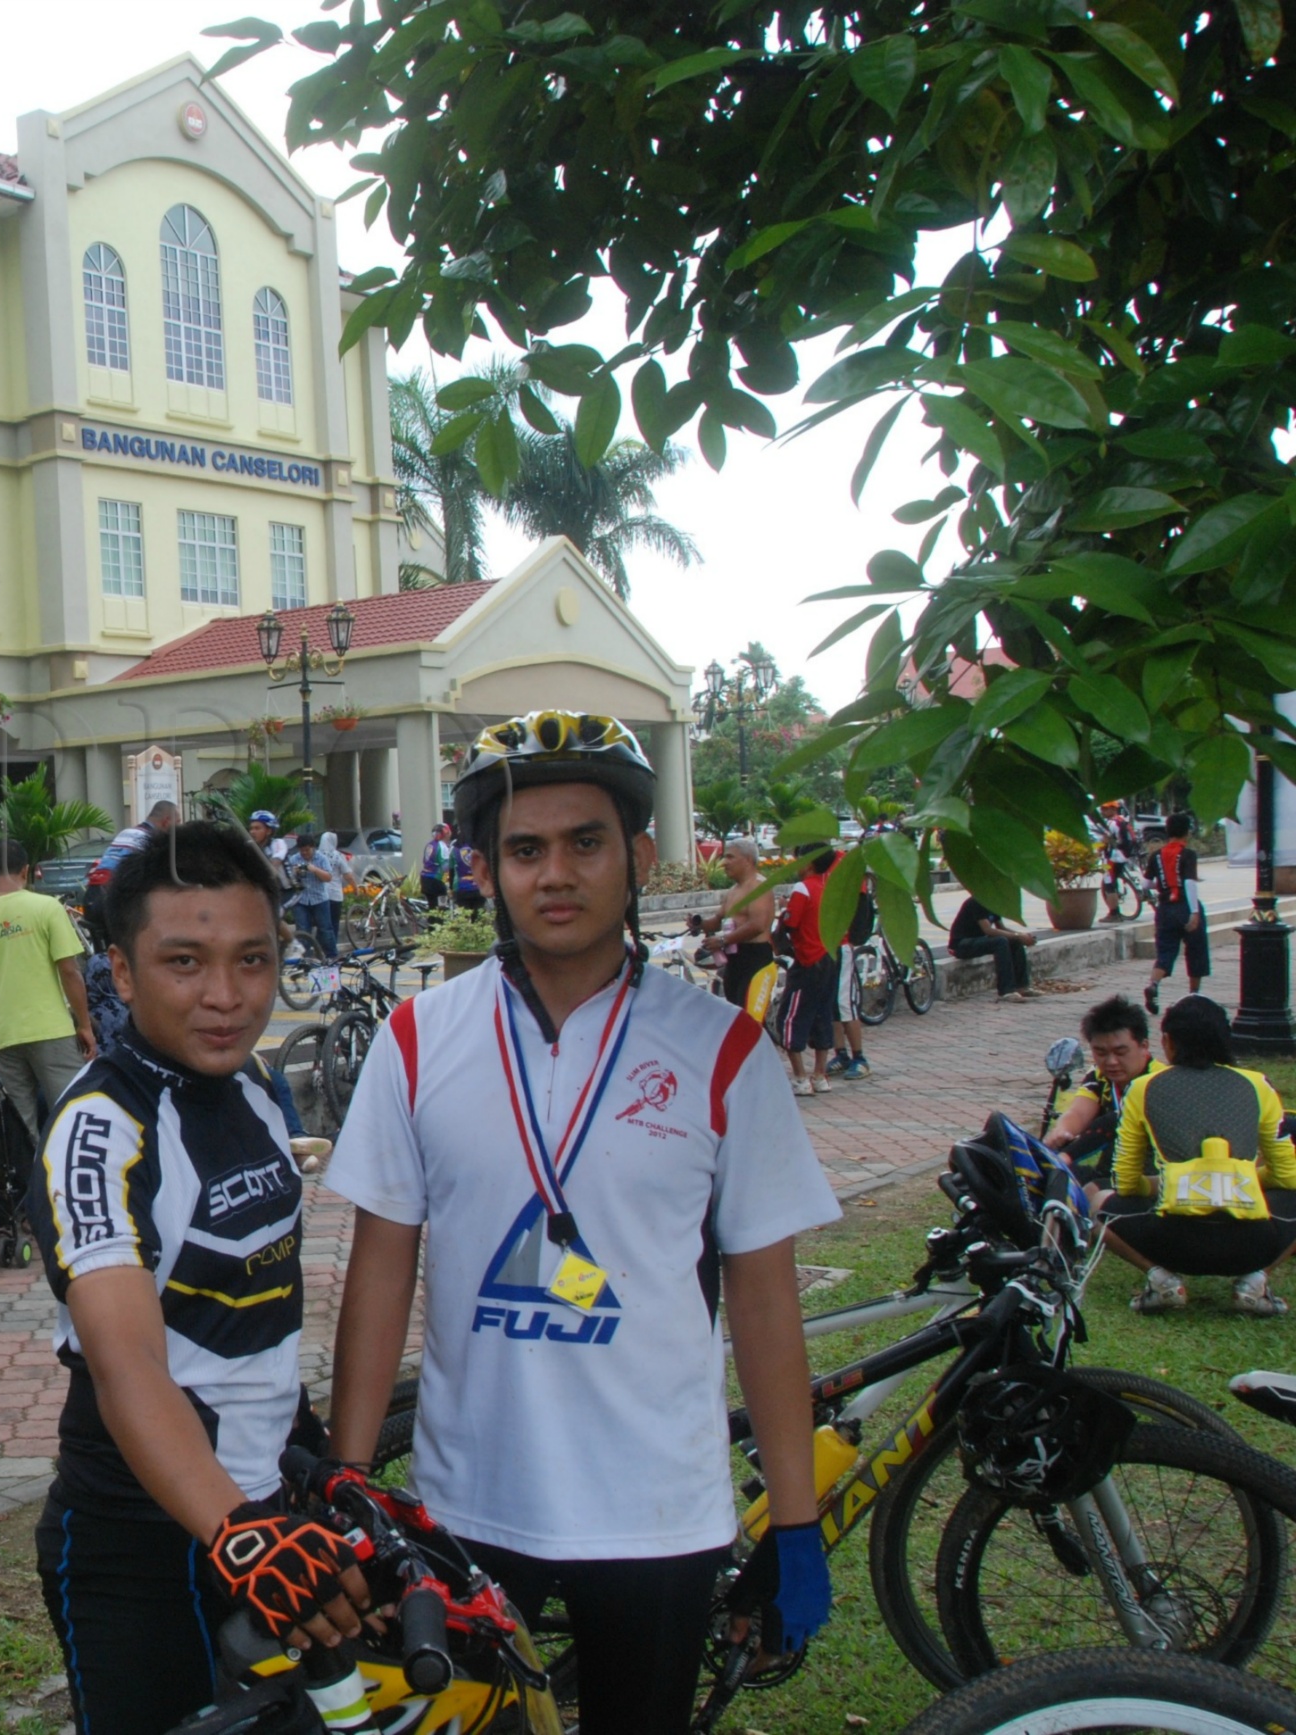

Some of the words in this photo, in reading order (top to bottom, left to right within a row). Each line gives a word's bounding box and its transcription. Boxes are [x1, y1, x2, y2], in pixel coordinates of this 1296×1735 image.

[81, 428, 206, 468] BANGUNAN
[211, 451, 320, 486] CANSELORI
[639, 1060, 659, 1071] RIVER
[627, 1118, 644, 1127] MTB
[645, 1122, 687, 1138] CHALLENGE
[648, 1130, 667, 1140] 2012
[70, 1113, 108, 1248] SCOTT
[209, 1160, 284, 1218] SCOTT
[471, 1305, 621, 1345] FUJI
[820, 1390, 938, 1548] IANT
[954, 1529, 979, 1590] KENDA
